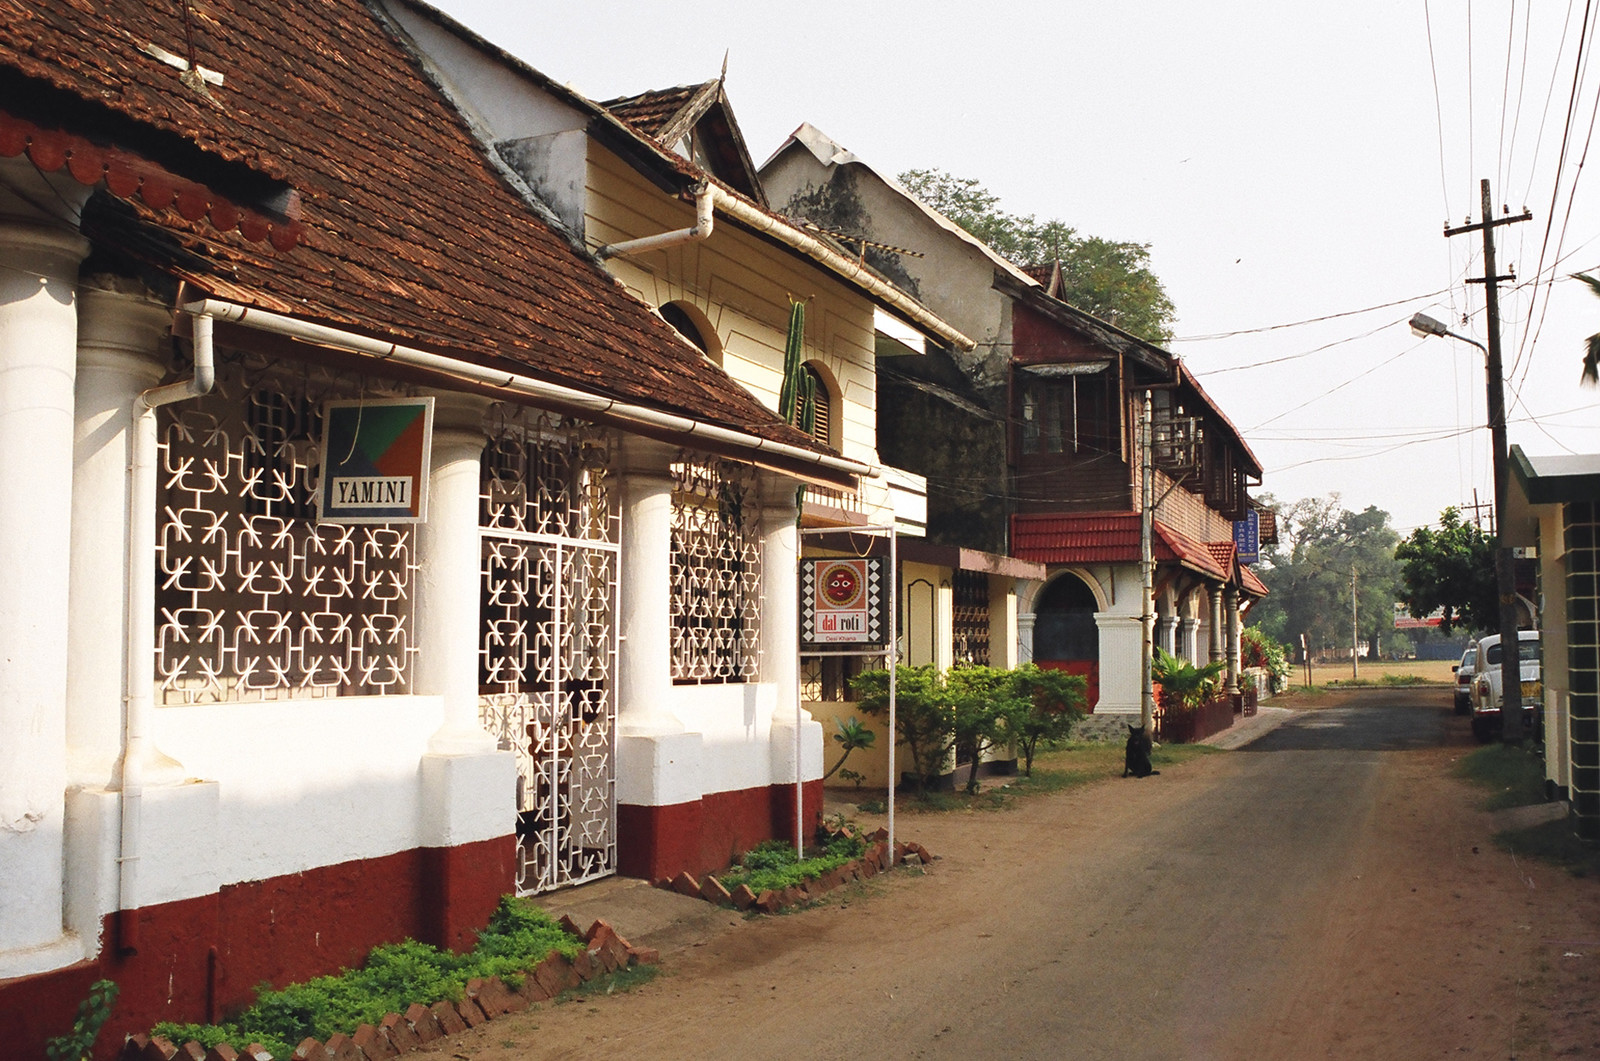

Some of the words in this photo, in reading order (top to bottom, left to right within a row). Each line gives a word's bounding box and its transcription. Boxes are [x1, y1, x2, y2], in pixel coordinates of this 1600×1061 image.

[338, 481, 406, 503] YAMINI
[822, 614, 837, 631] dal
[841, 614, 859, 631] roti
